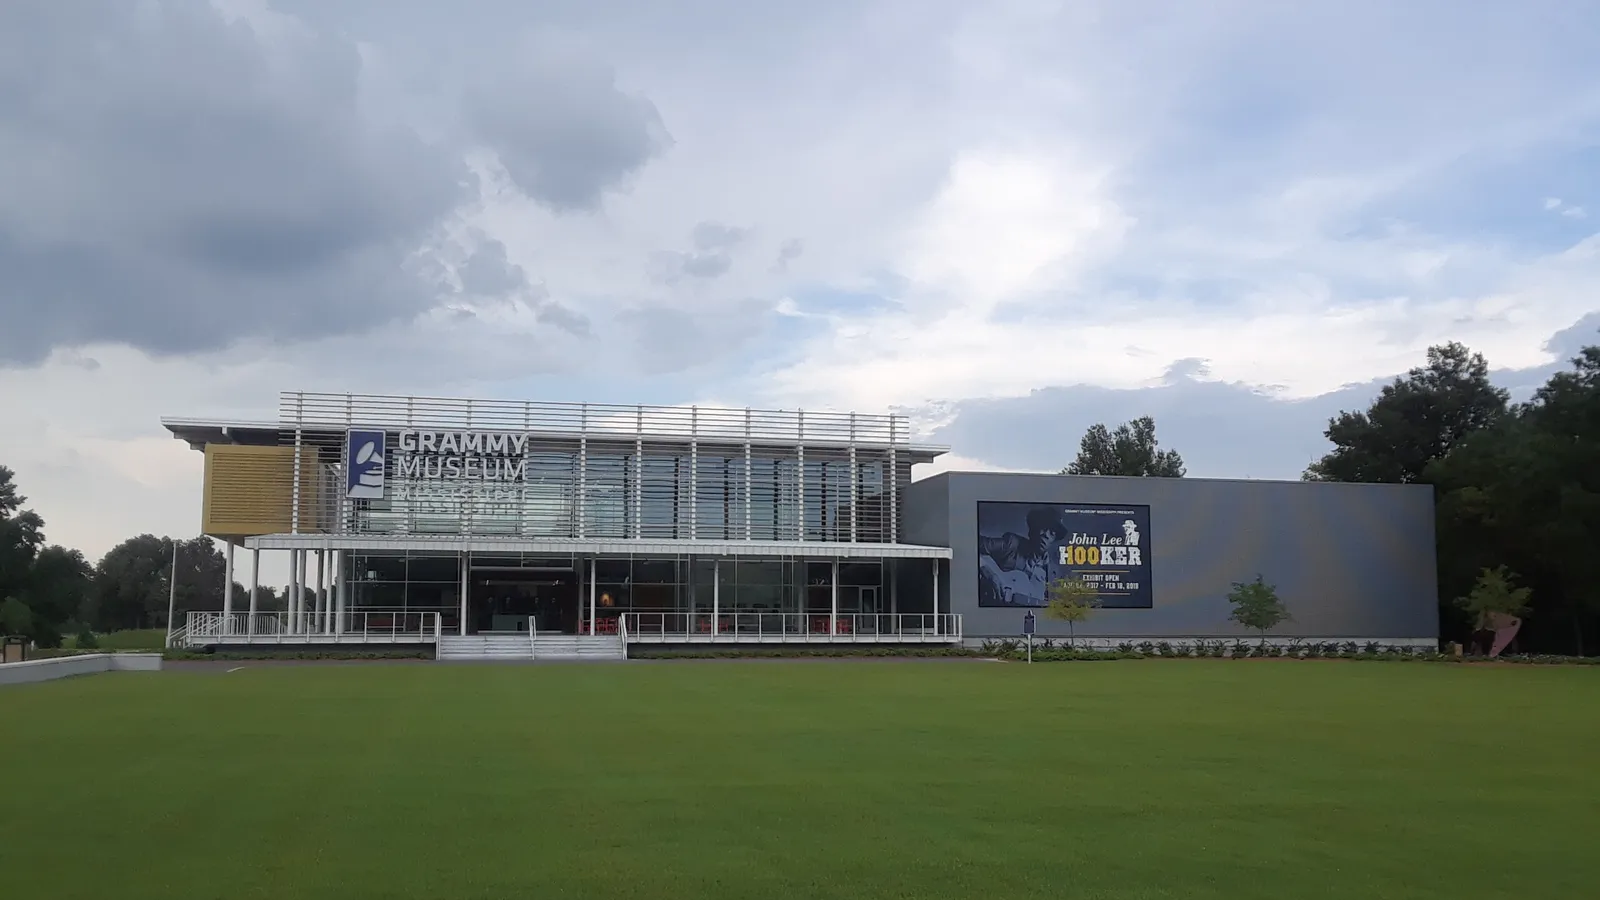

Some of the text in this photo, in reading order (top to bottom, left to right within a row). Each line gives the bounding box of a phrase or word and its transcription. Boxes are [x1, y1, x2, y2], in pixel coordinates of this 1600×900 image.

[399, 430, 528, 454] GRAMMY
[397, 456, 527, 480] MUSEUM
[1069, 532, 1122, 545] John Lee
[1082, 574, 1120, 582] EXHIBIT OPEN
[1105, 582, 1116, 590] FEB
